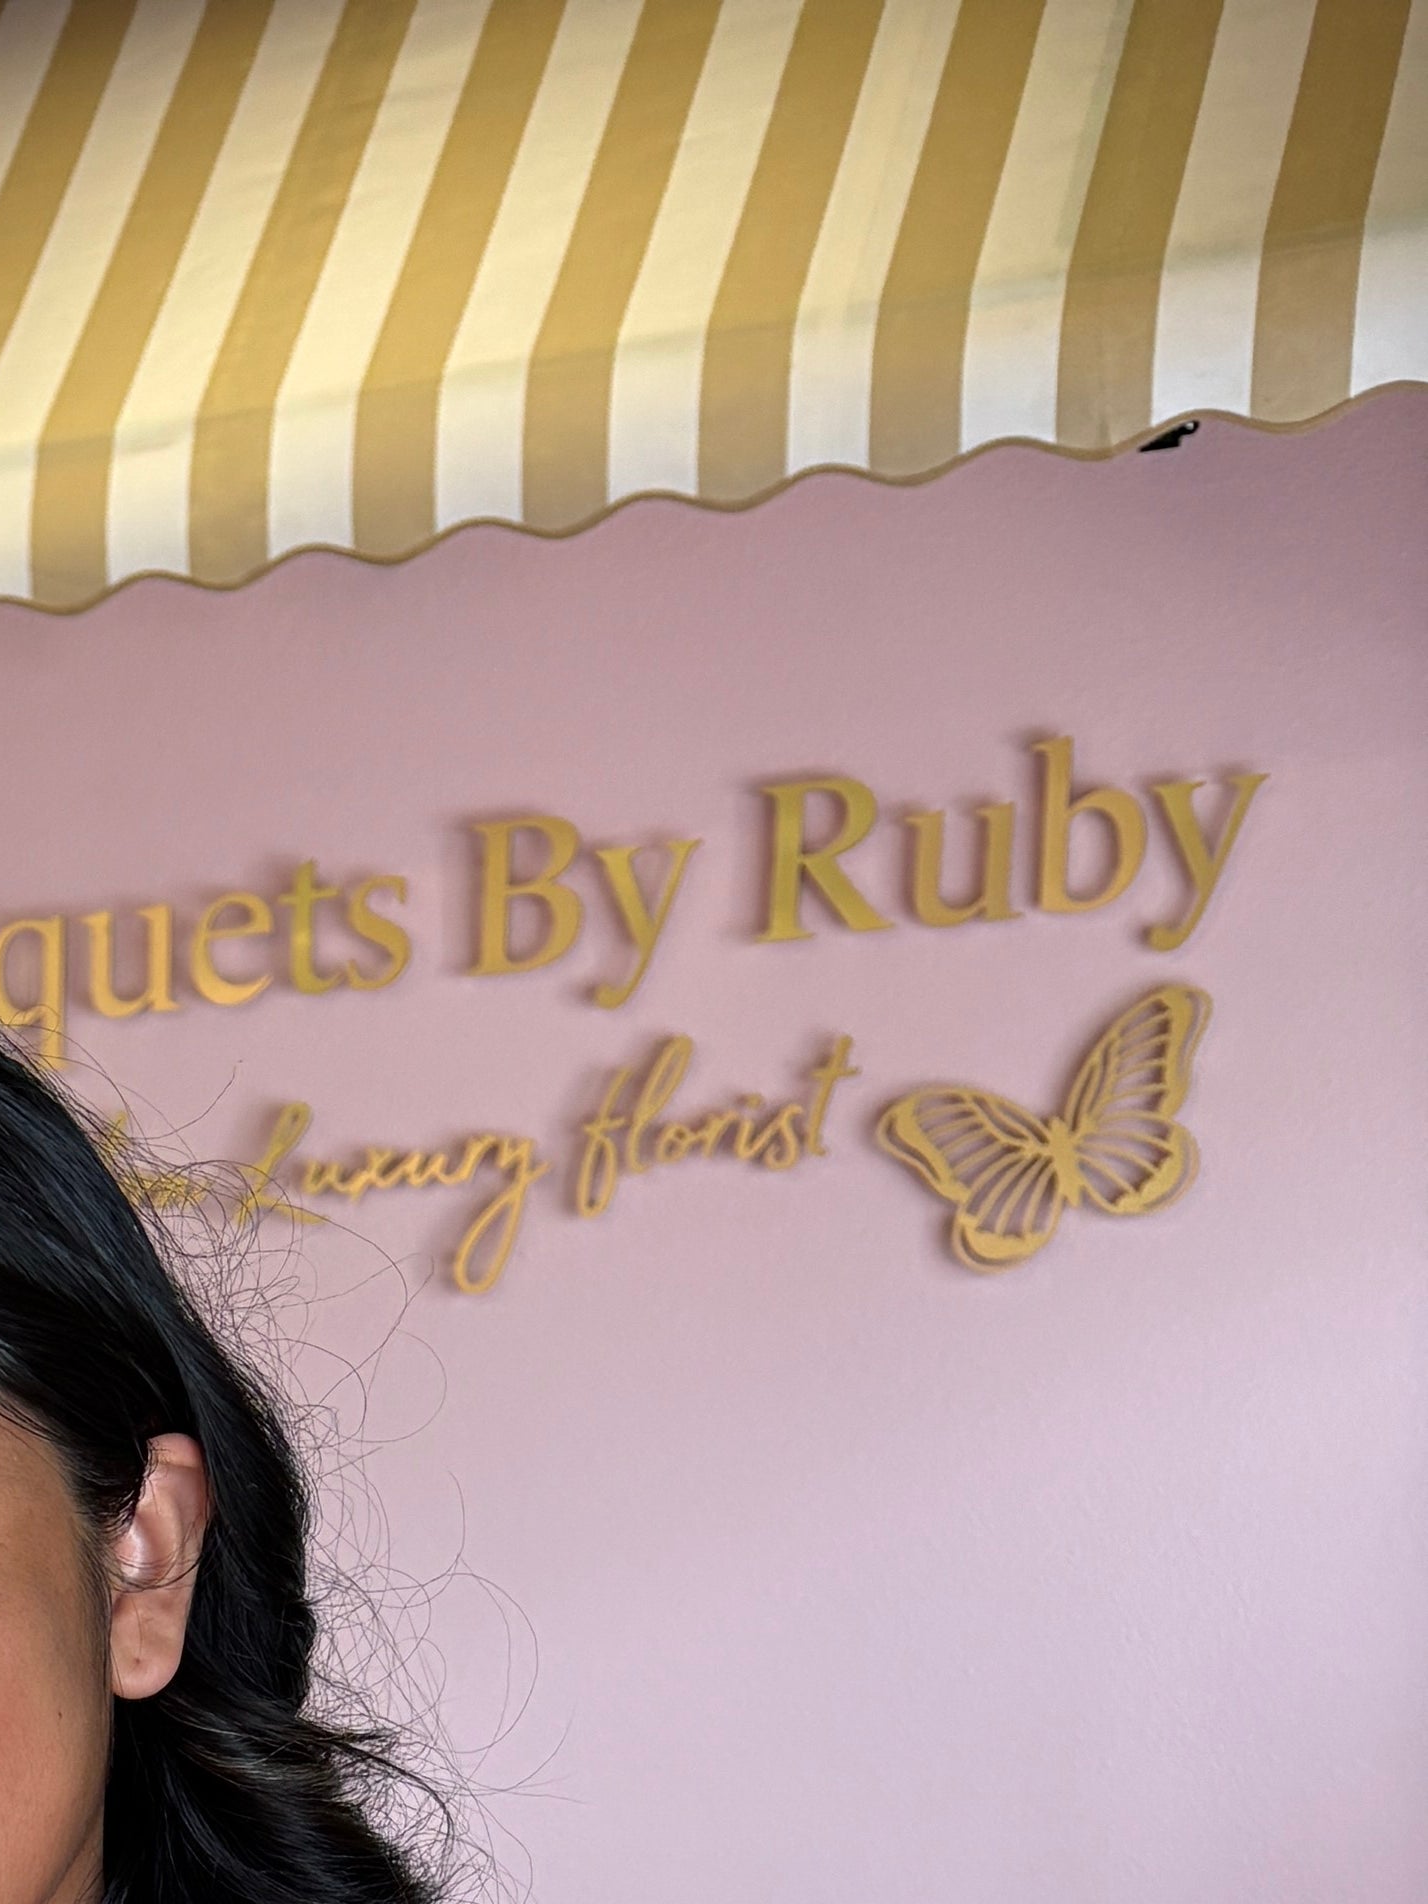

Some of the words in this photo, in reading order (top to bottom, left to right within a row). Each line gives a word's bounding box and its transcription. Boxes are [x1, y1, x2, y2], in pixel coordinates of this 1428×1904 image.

[466, 815, 702, 1009] By
[752, 734, 1269, 951] Ruby
[577, 1035, 860, 1217] florist
